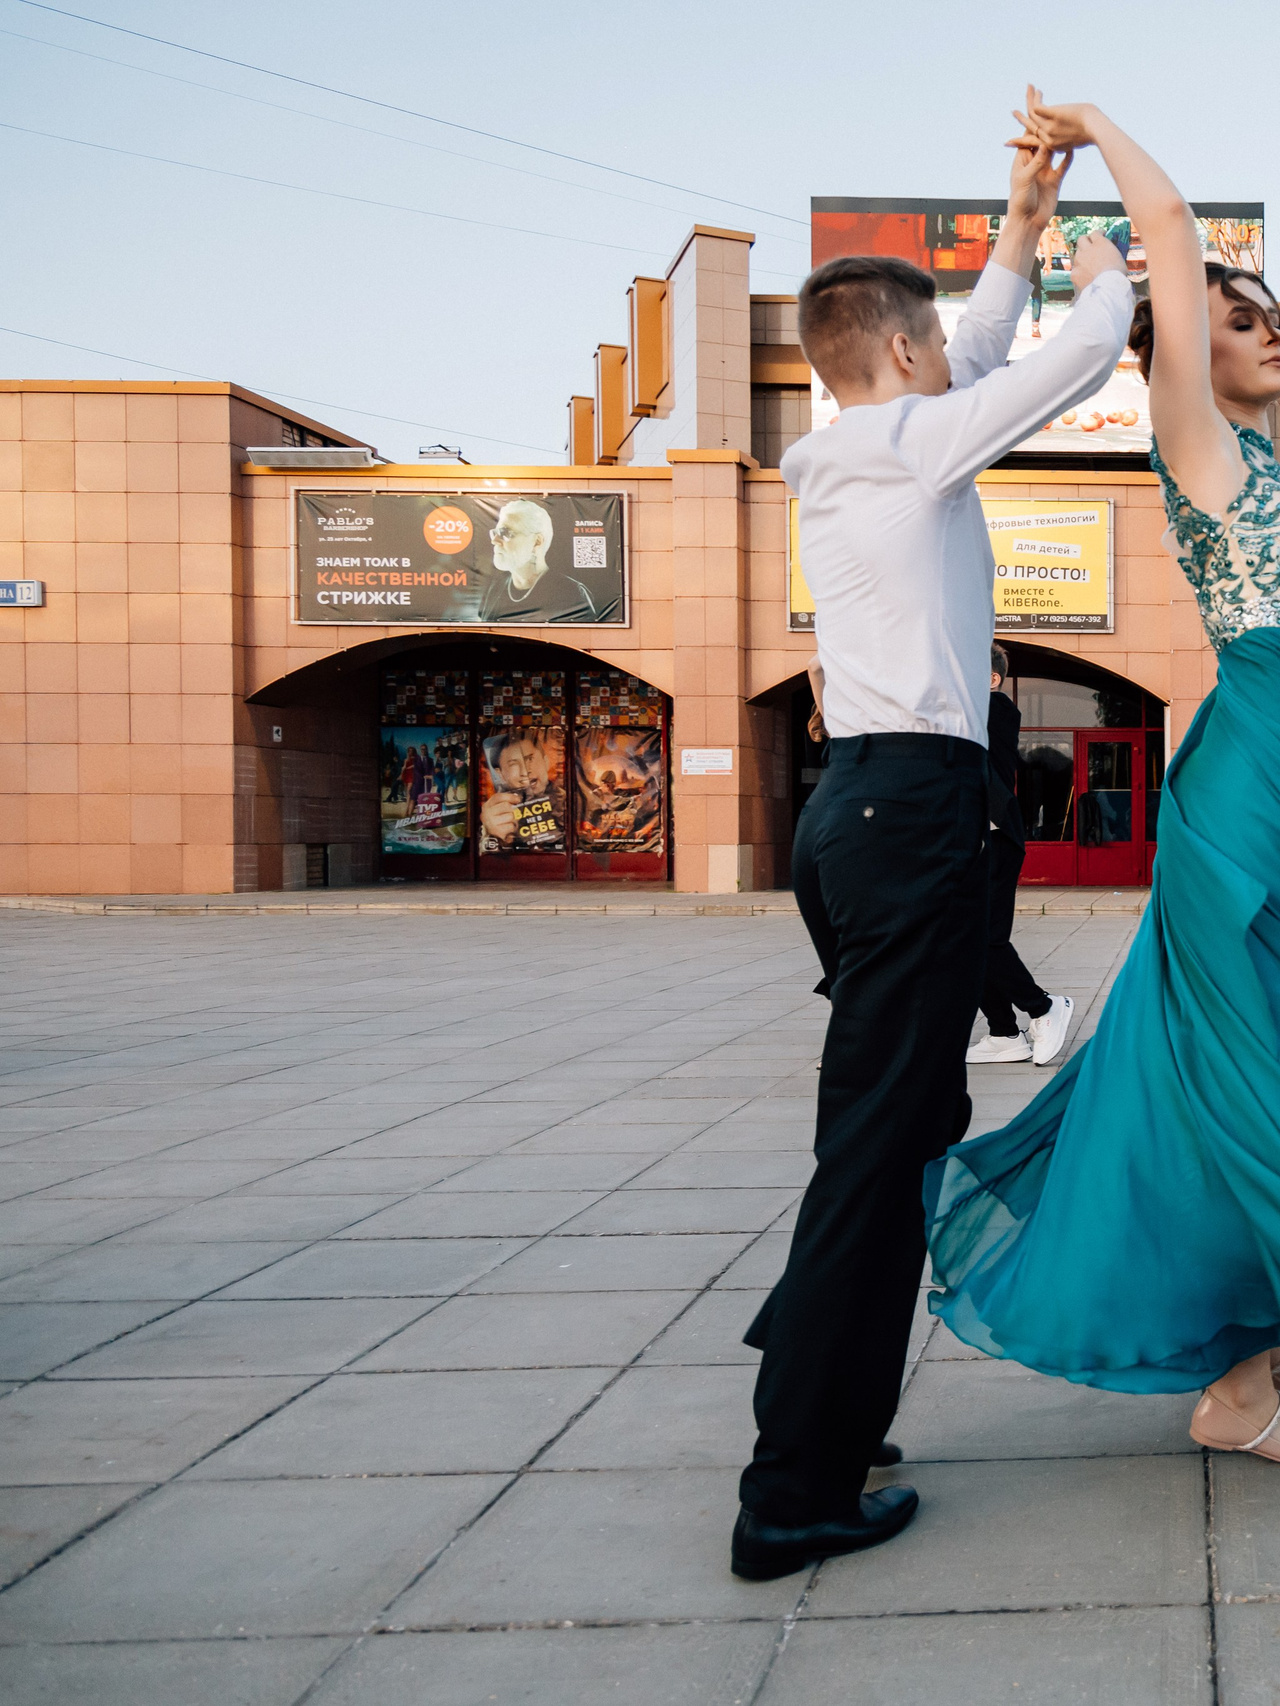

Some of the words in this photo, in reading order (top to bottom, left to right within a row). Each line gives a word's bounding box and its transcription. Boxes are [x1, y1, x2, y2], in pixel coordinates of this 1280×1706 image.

[317, 517, 374, 526] PABLO'S
[1035, 515, 1096, 525] технологии
[428, 520, 469, 533] -20%
[1016, 543, 1036, 551] для
[1039, 546, 1070, 555] детей
[316, 557, 361, 567] ЗНАЕМ
[363, 557, 399, 567] ТОЛК
[401, 557, 411, 567] В
[317, 570, 467, 586] КАЧЕСТВЕННОЙ
[1014, 565, 1087, 581] ПРОСТО!
[19, 586, 32, 600] 12
[316, 591, 411, 605] СТРИЖКЕ
[1003, 588, 1045, 596] вместе
[1048, 588, 1055, 596] с
[1003, 597, 1064, 608] KIBERone.
[1049, 615, 1068, 623] (925)
[1068, 615, 1102, 623] 4567-392
[513, 801, 552, 820] ВАСЯ
[519, 819, 557, 837] СЕБЕ
